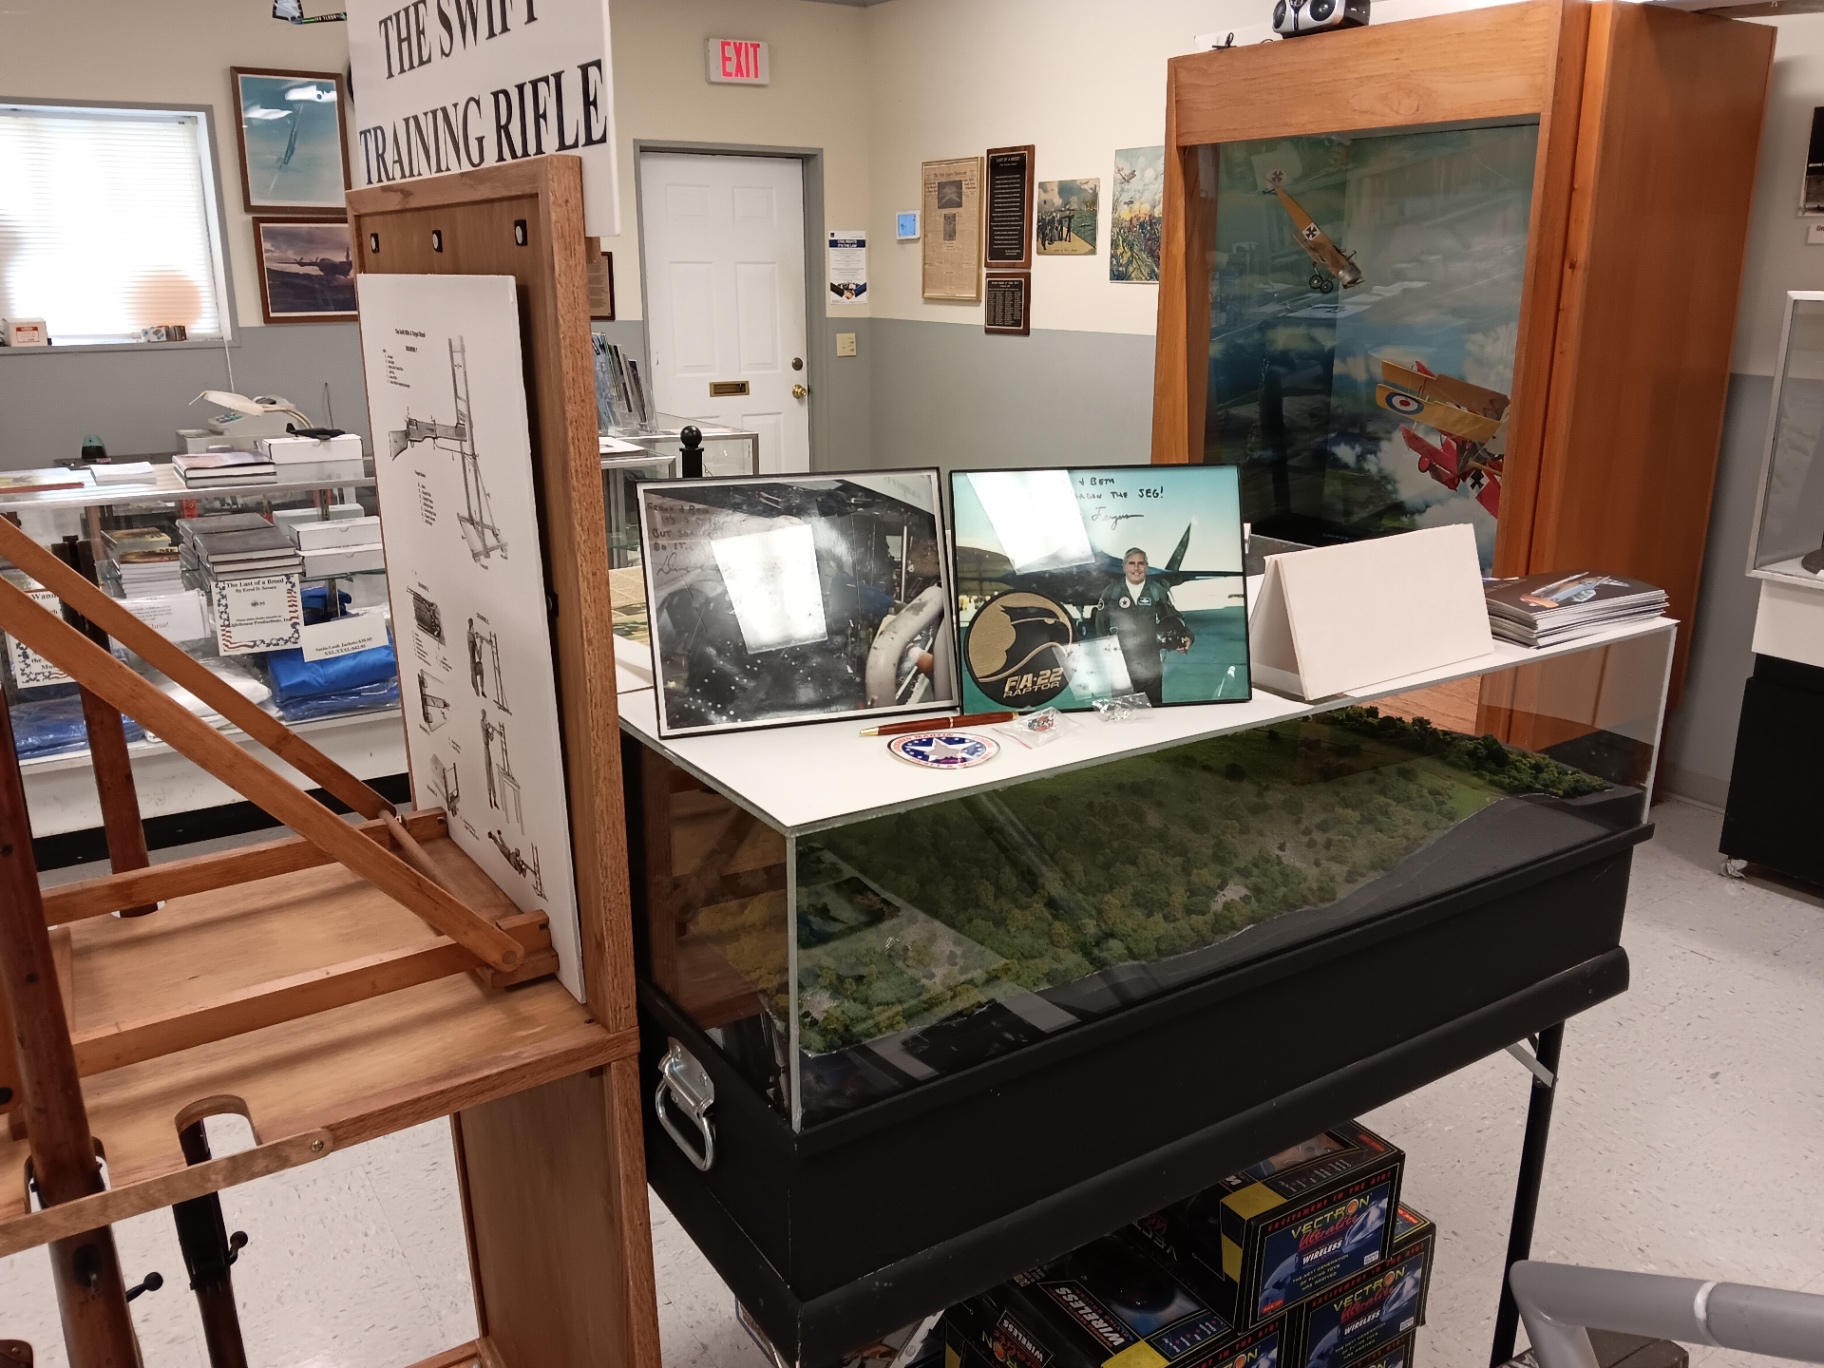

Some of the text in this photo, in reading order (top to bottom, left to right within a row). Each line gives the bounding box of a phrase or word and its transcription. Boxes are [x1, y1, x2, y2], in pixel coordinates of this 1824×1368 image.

[379, 0, 432, 80] THE
[720, 40, 760, 79] EXIT
[359, 58, 607, 185] TRAINING RIFLE
[1003, 681, 1060, 698] RAPTOR
[1268, 1199, 1328, 1232] EXCITEMENT
[1333, 1192, 1344, 1201] IN
[1349, 1181, 1365, 1195] THE
[1291, 1195, 1371, 1239] VECTRON
[1302, 1240, 1343, 1265] WIRELESS
[1333, 1266, 1406, 1312] VECTRON
[1055, 1286, 1126, 1347] WIRELESS
[1344, 1309, 1382, 1335] WIRELESS
[1002, 1319, 1044, 1363] WIRELESS
